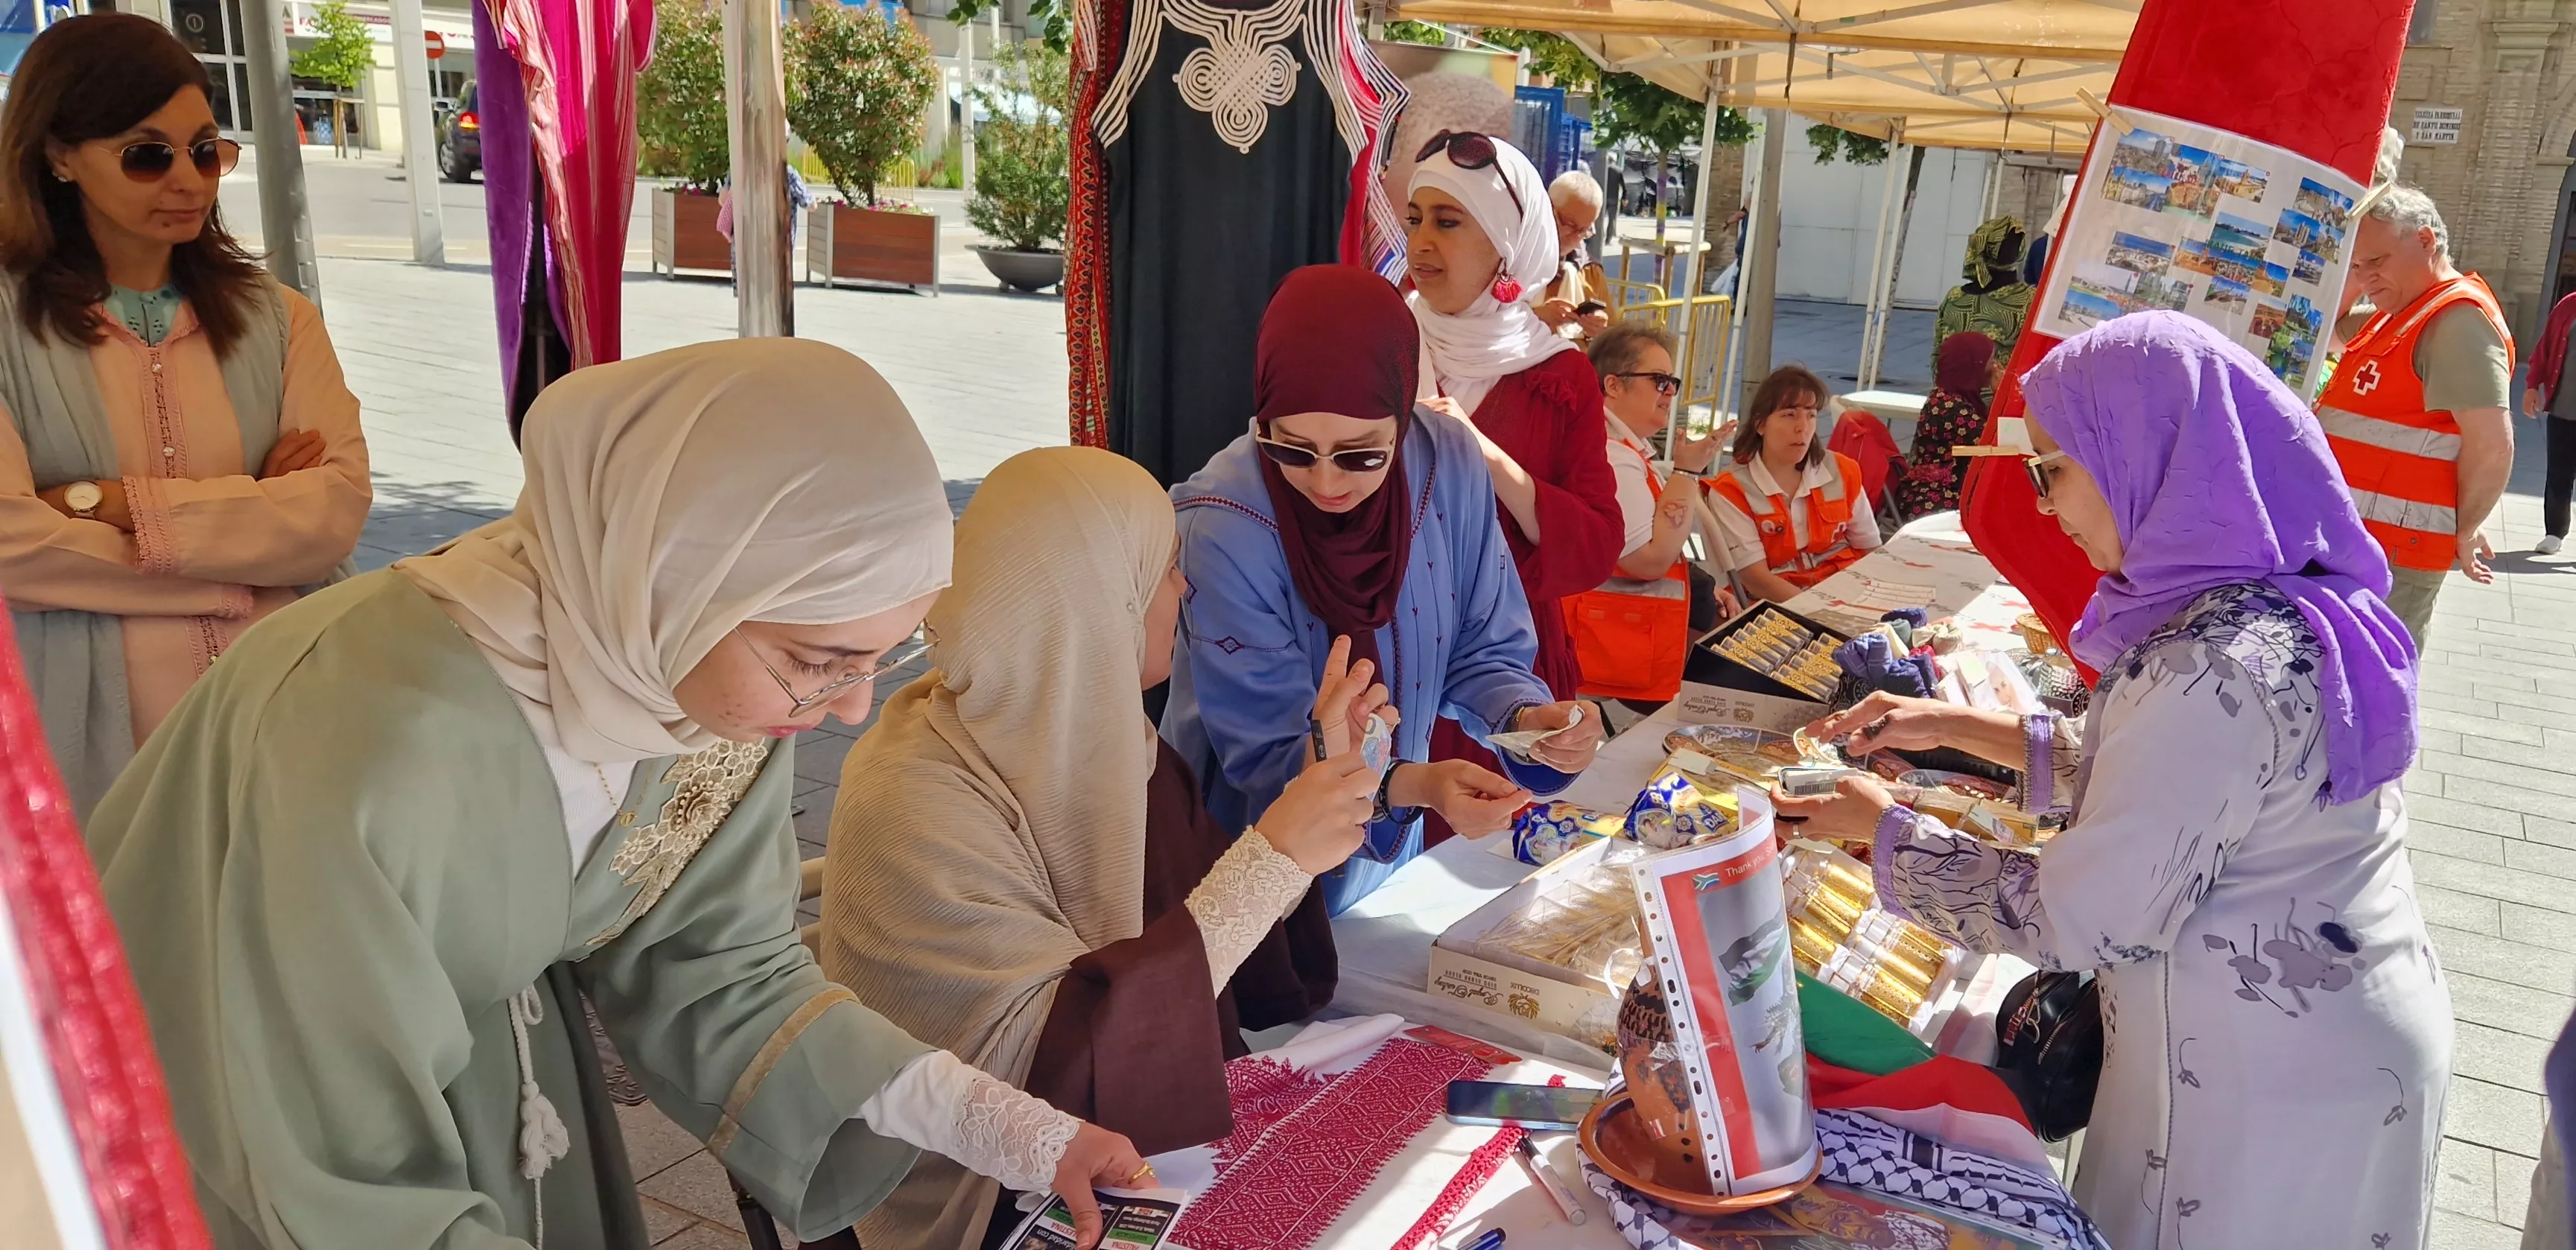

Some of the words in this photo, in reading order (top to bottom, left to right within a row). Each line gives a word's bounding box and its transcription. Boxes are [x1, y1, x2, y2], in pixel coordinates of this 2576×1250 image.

[1725, 859, 1752, 878] Thank
[1468, 986, 1504, 1006] Royal
[1036, 1228, 1050, 1237] con
[1050, 1222, 1077, 1237] LESTINA
